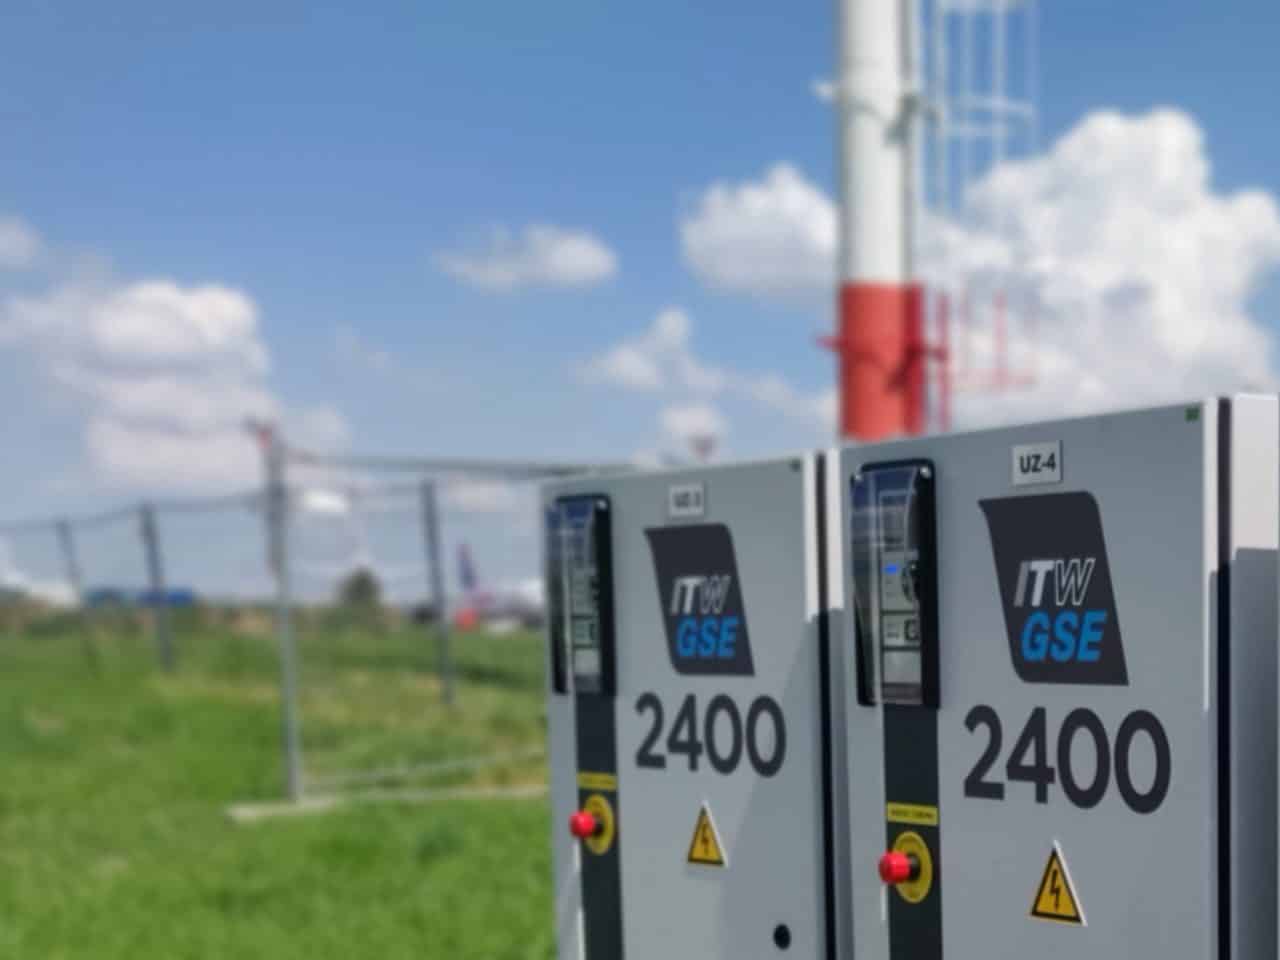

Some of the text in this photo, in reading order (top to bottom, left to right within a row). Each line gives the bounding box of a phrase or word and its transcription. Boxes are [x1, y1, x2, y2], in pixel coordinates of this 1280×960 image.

[1019, 452, 1057, 475] UZ-4
[671, 574, 731, 615] ITW
[1013, 557, 1096, 607] ITW
[675, 614, 739, 658] GSE
[1020, 609, 1107, 662] GSE
[634, 691, 787, 778] 2400
[963, 704, 1172, 815] 2400
